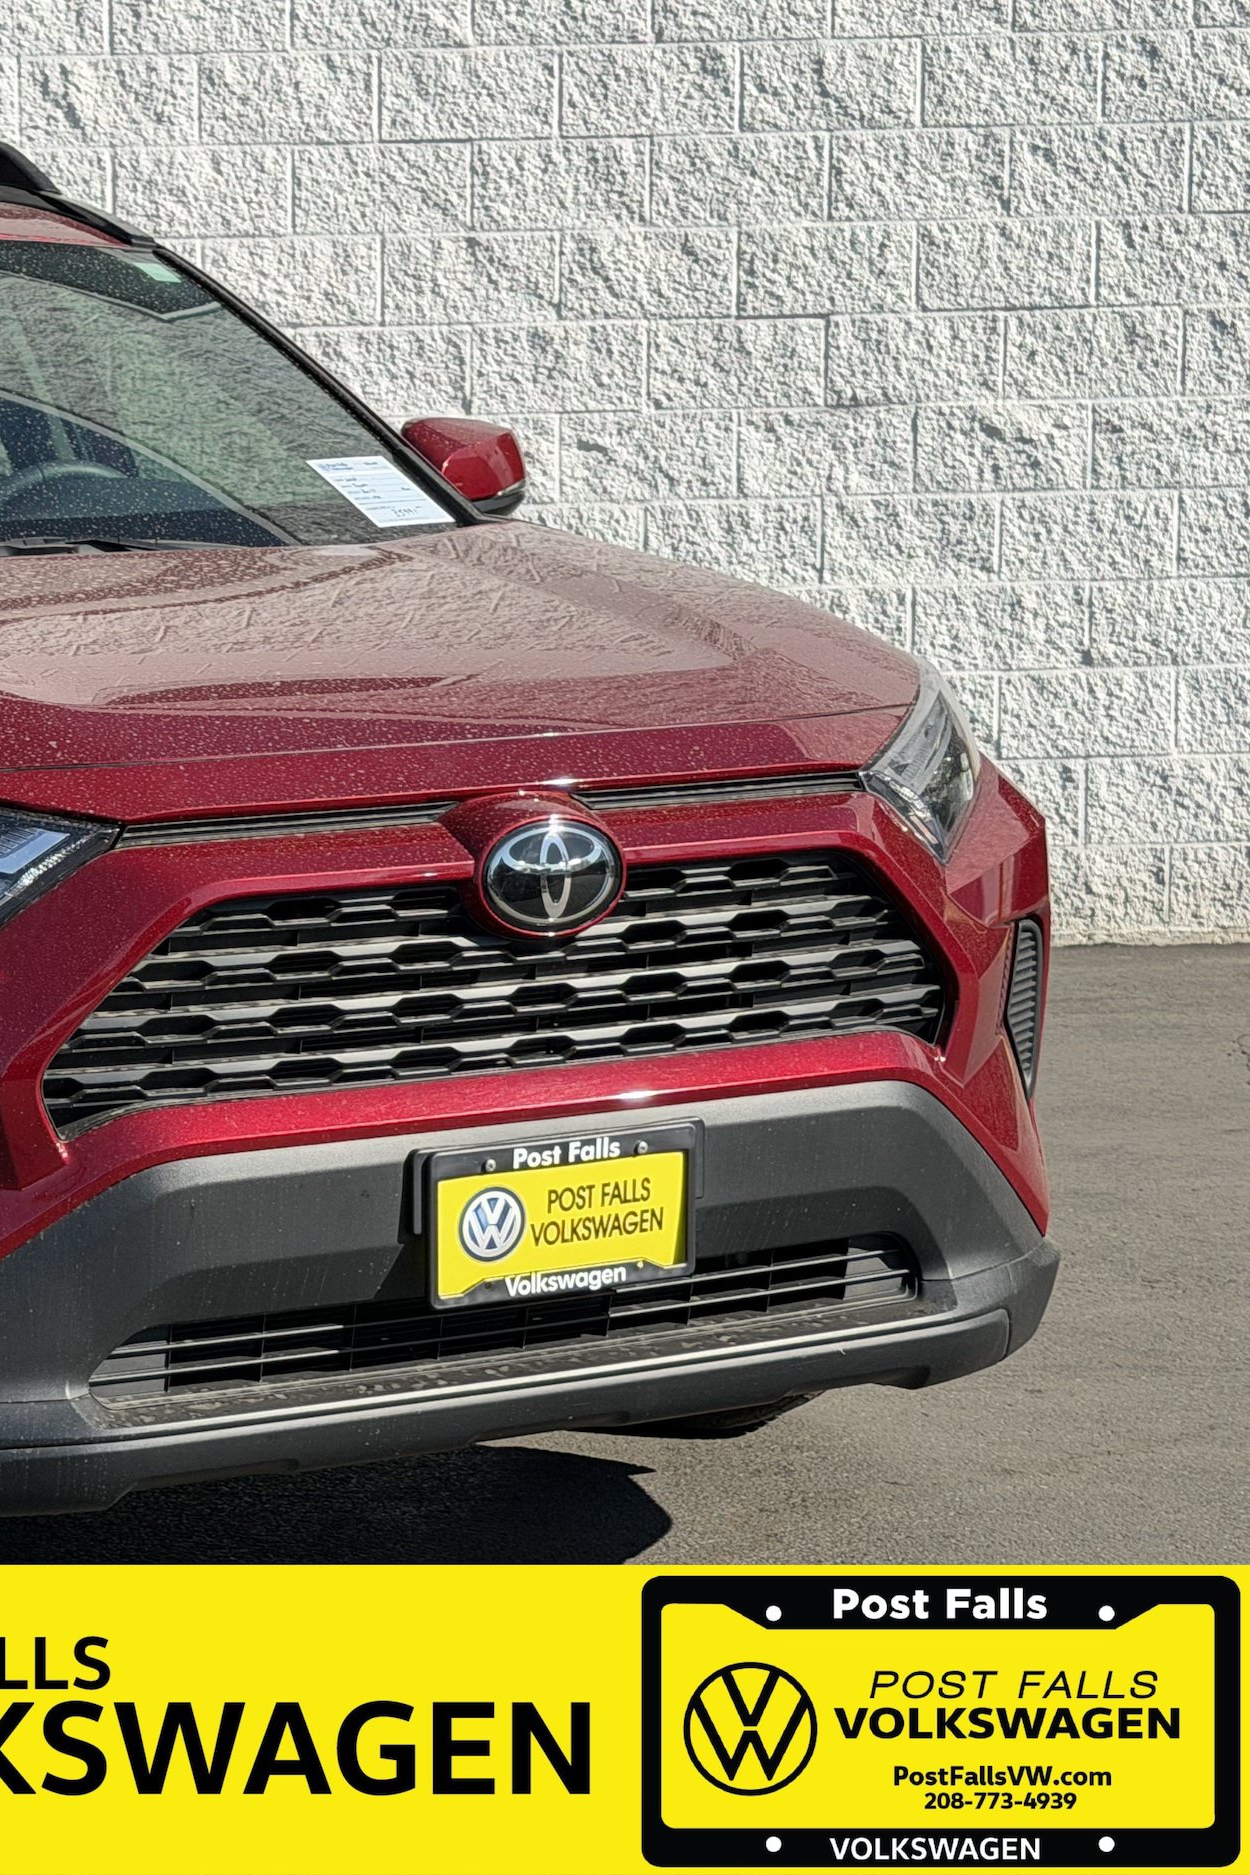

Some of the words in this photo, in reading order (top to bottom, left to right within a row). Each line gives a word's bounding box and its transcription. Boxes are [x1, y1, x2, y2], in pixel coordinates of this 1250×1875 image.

[512, 1145, 562, 1169] Post
[568, 1136, 621, 1164] Falls
[548, 1185, 595, 1213] POST
[602, 1177, 650, 1205] FALLS
[530, 1207, 663, 1247] VOLKSWAGEN
[505, 1266, 626, 1297] Volkswagen
